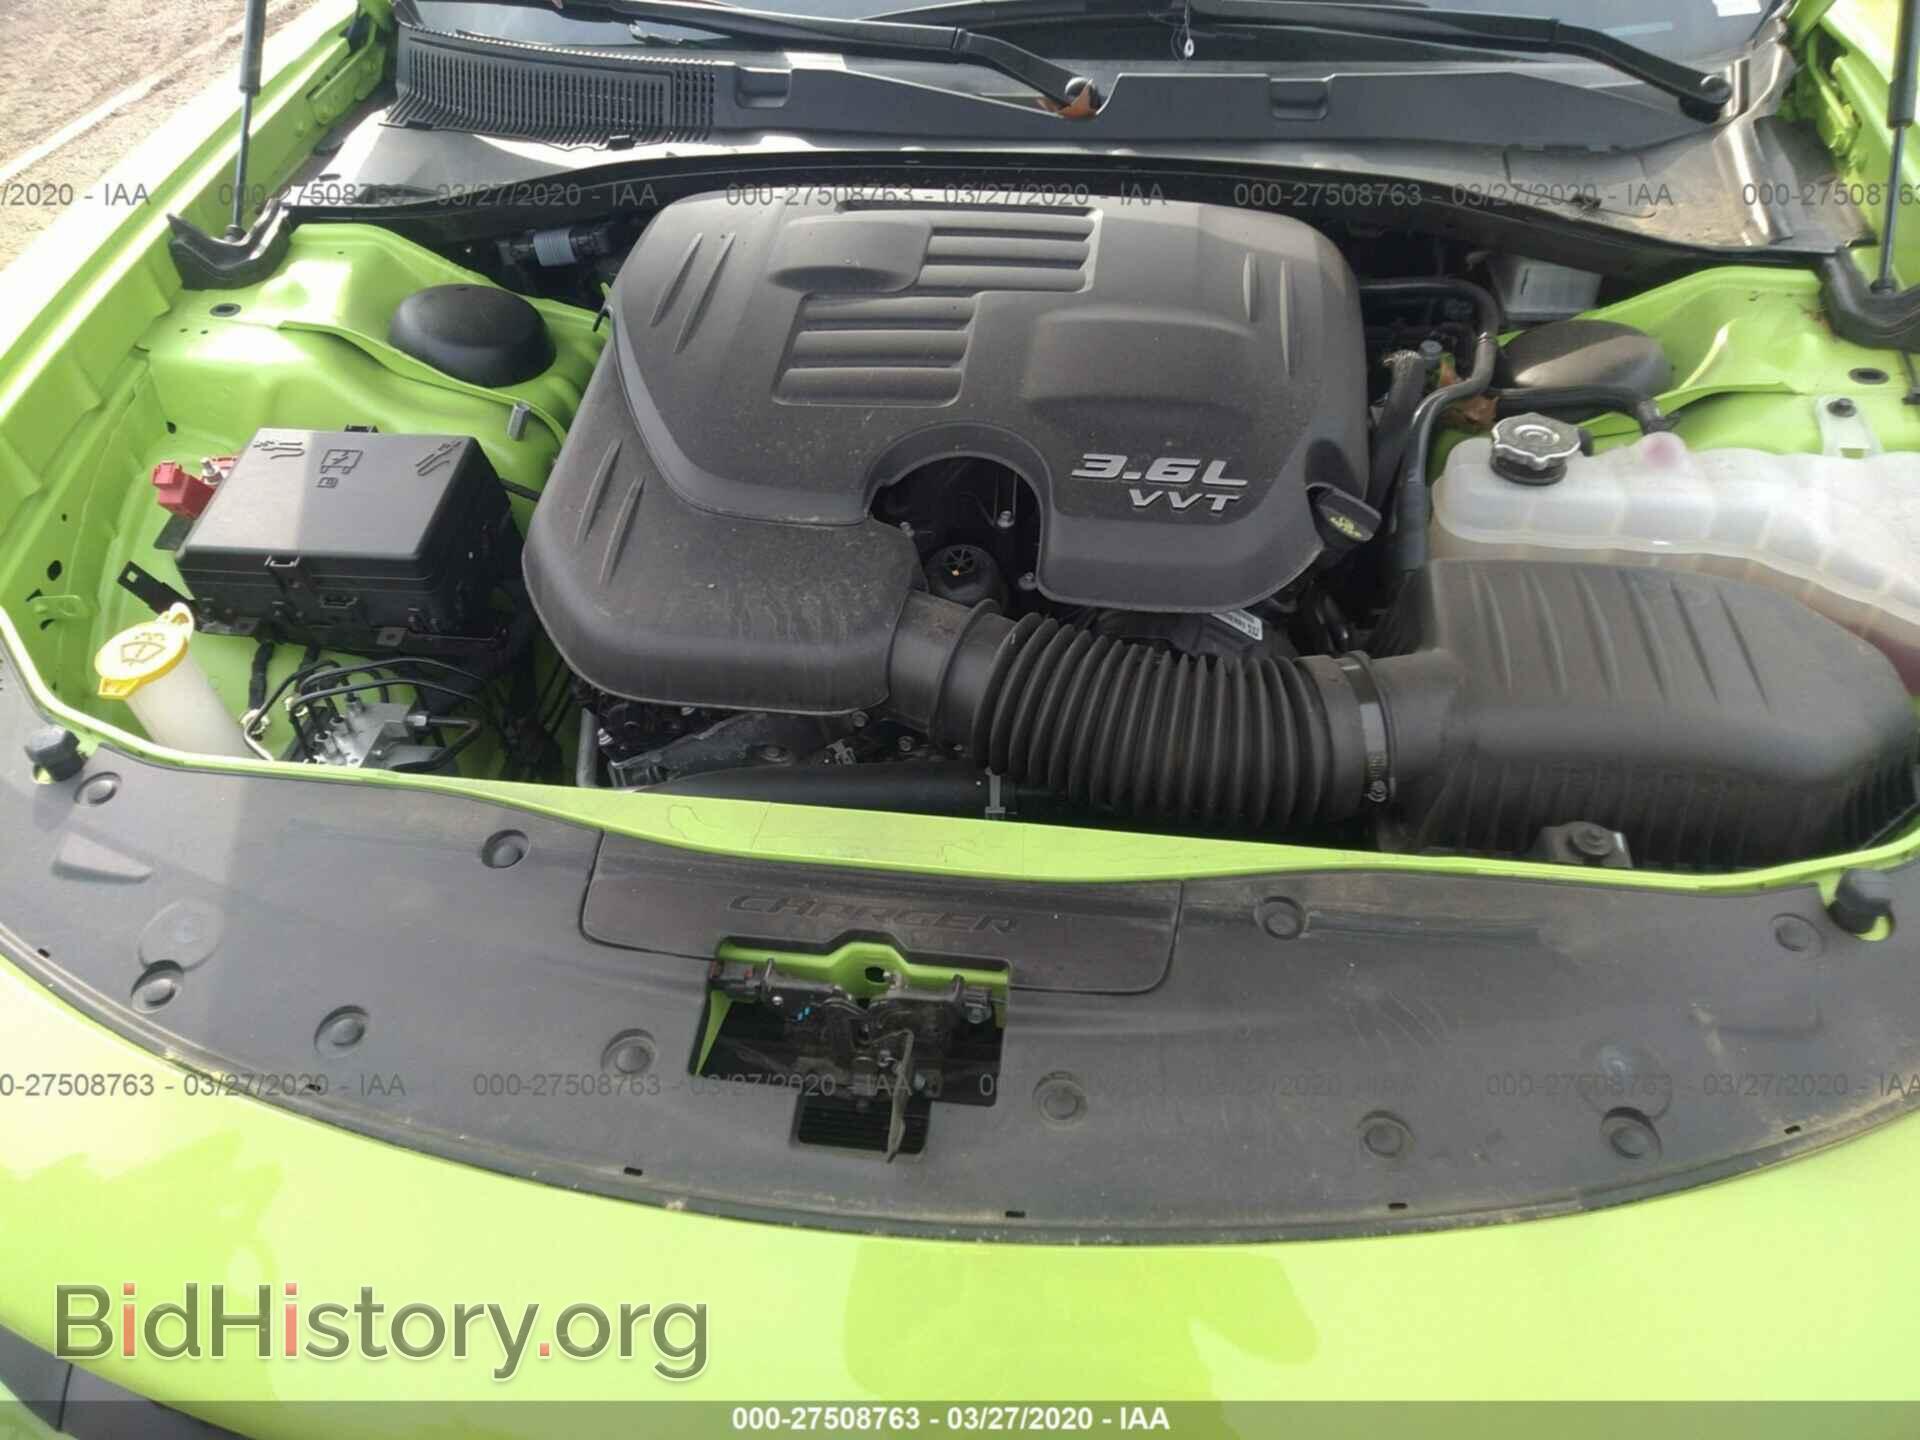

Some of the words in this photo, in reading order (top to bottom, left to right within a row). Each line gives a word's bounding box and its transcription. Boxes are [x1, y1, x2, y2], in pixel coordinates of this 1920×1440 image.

[1072, 453, 1248, 486] 3.6L
[1128, 488, 1241, 511] VVT
[728, 895, 1016, 934] CHARGER
